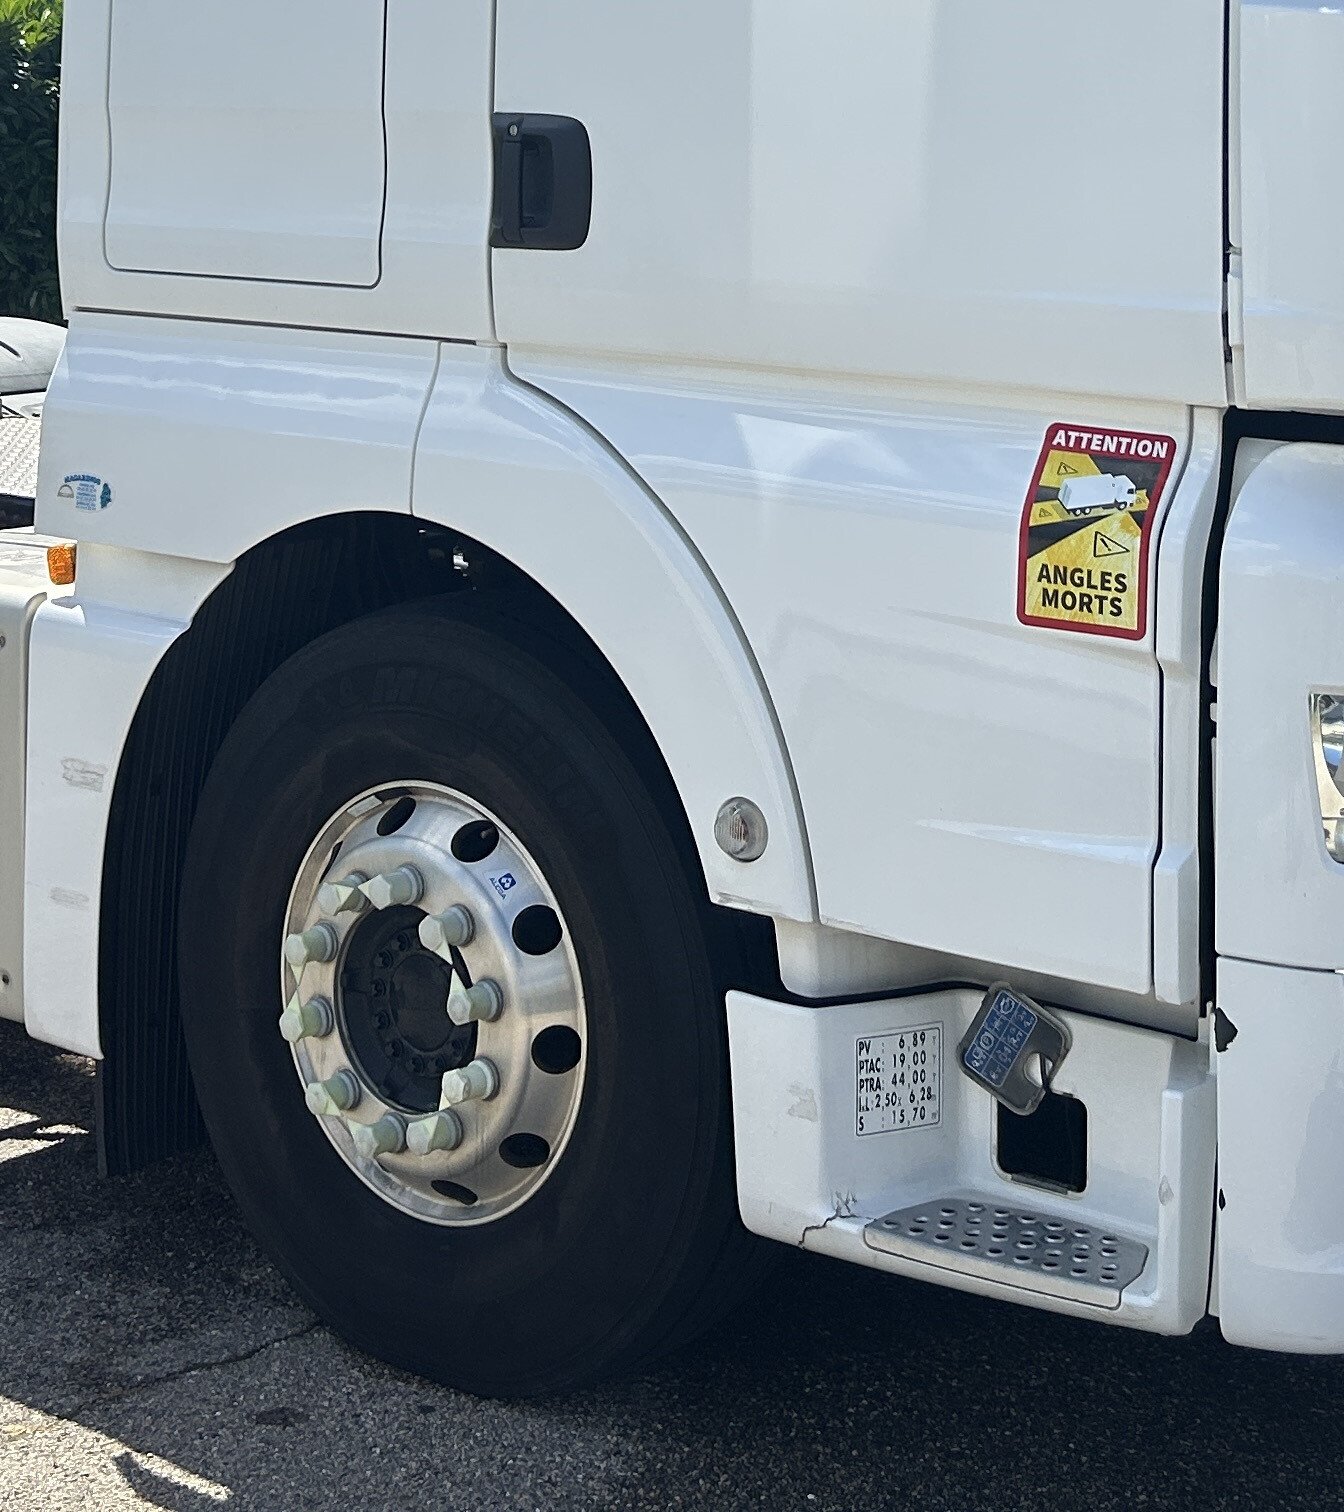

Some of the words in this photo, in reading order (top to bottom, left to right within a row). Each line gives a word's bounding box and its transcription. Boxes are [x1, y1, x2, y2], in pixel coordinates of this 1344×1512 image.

[1052, 429, 1169, 459] ATTENTION
[1037, 563, 1128, 594] ANGLES
[1041, 588, 1123, 617] MORTS
[858, 1039, 872, 1057] PV
[892, 1049, 927, 1072] 19,00
[891, 1068, 927, 1090] 44,00
